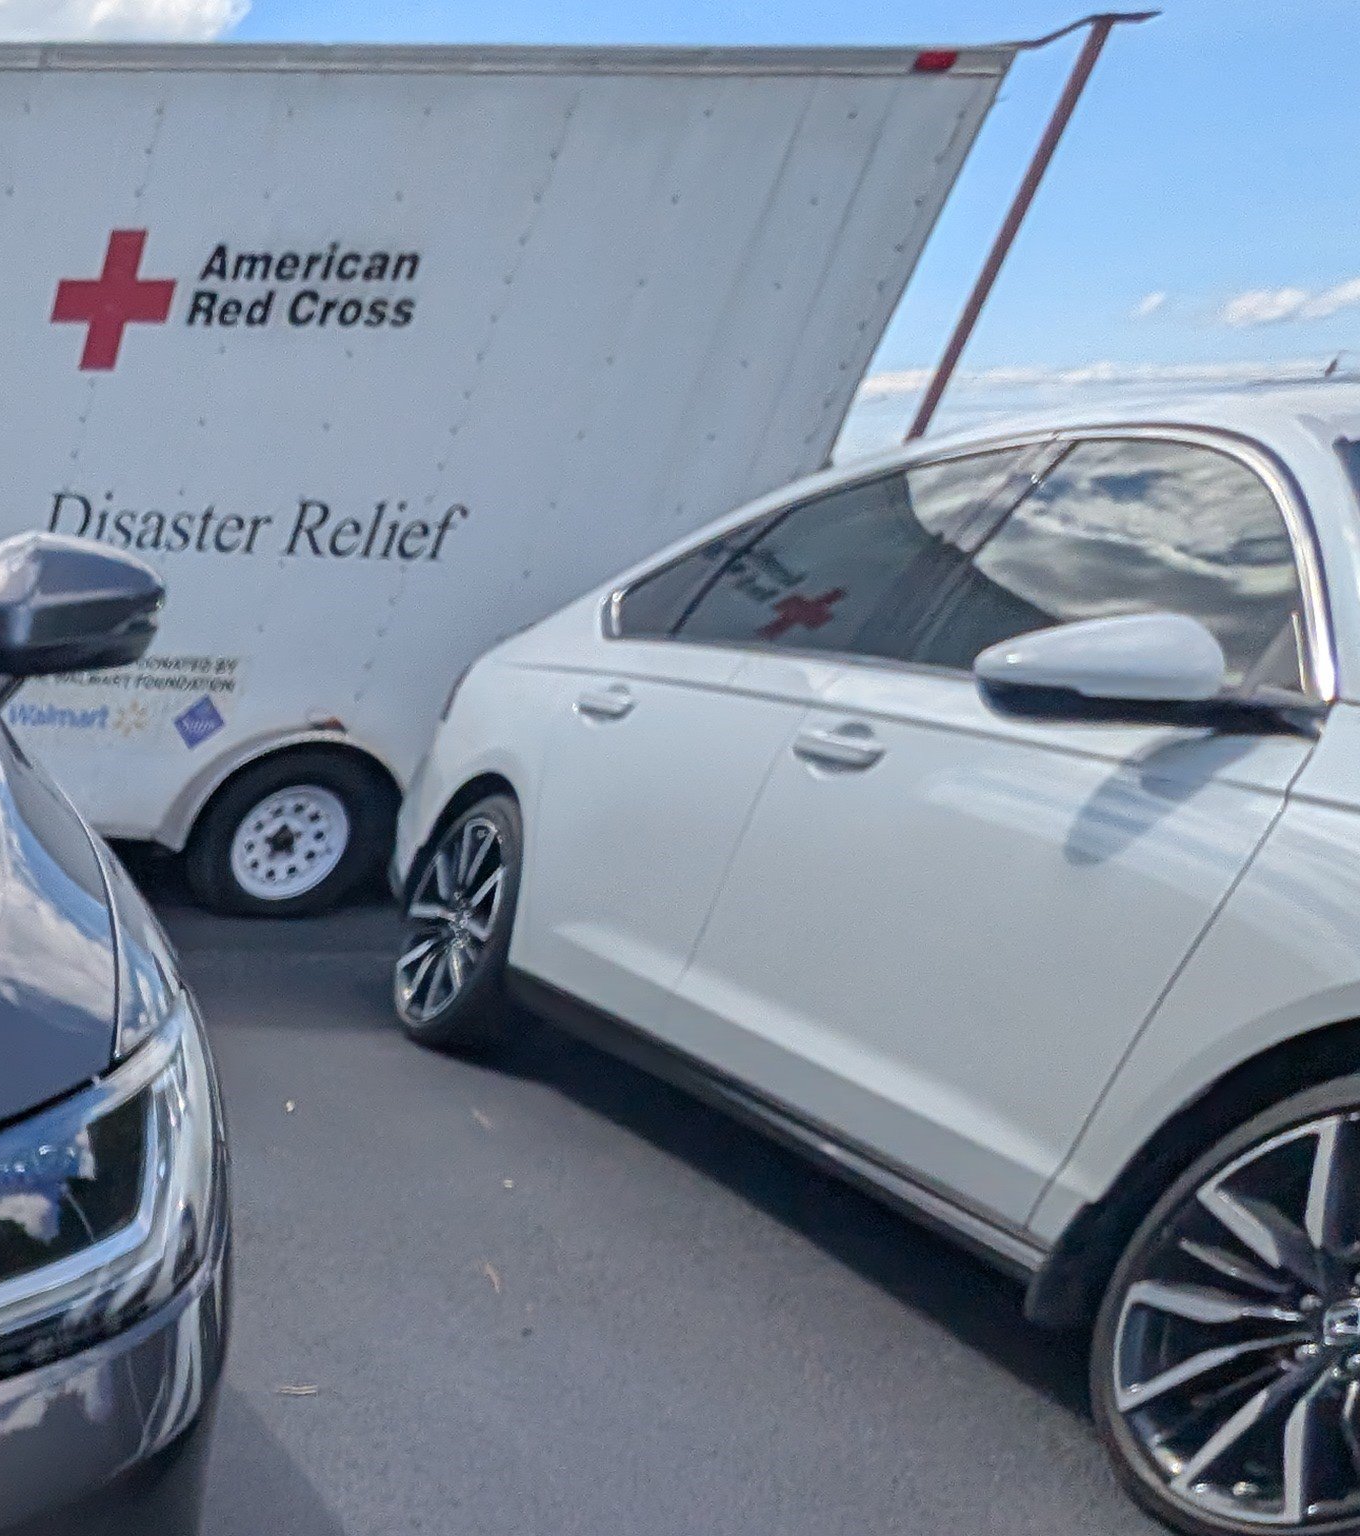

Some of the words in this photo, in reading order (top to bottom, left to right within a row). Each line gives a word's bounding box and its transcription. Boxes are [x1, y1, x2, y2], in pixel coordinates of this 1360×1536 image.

[199, 241, 421, 281] American
[186, 290, 276, 327] Red
[288, 290, 417, 328] Cross
[47, 490, 273, 555] Disaster
[285, 498, 469, 561] Relief
[8, 702, 109, 729] Walmart
